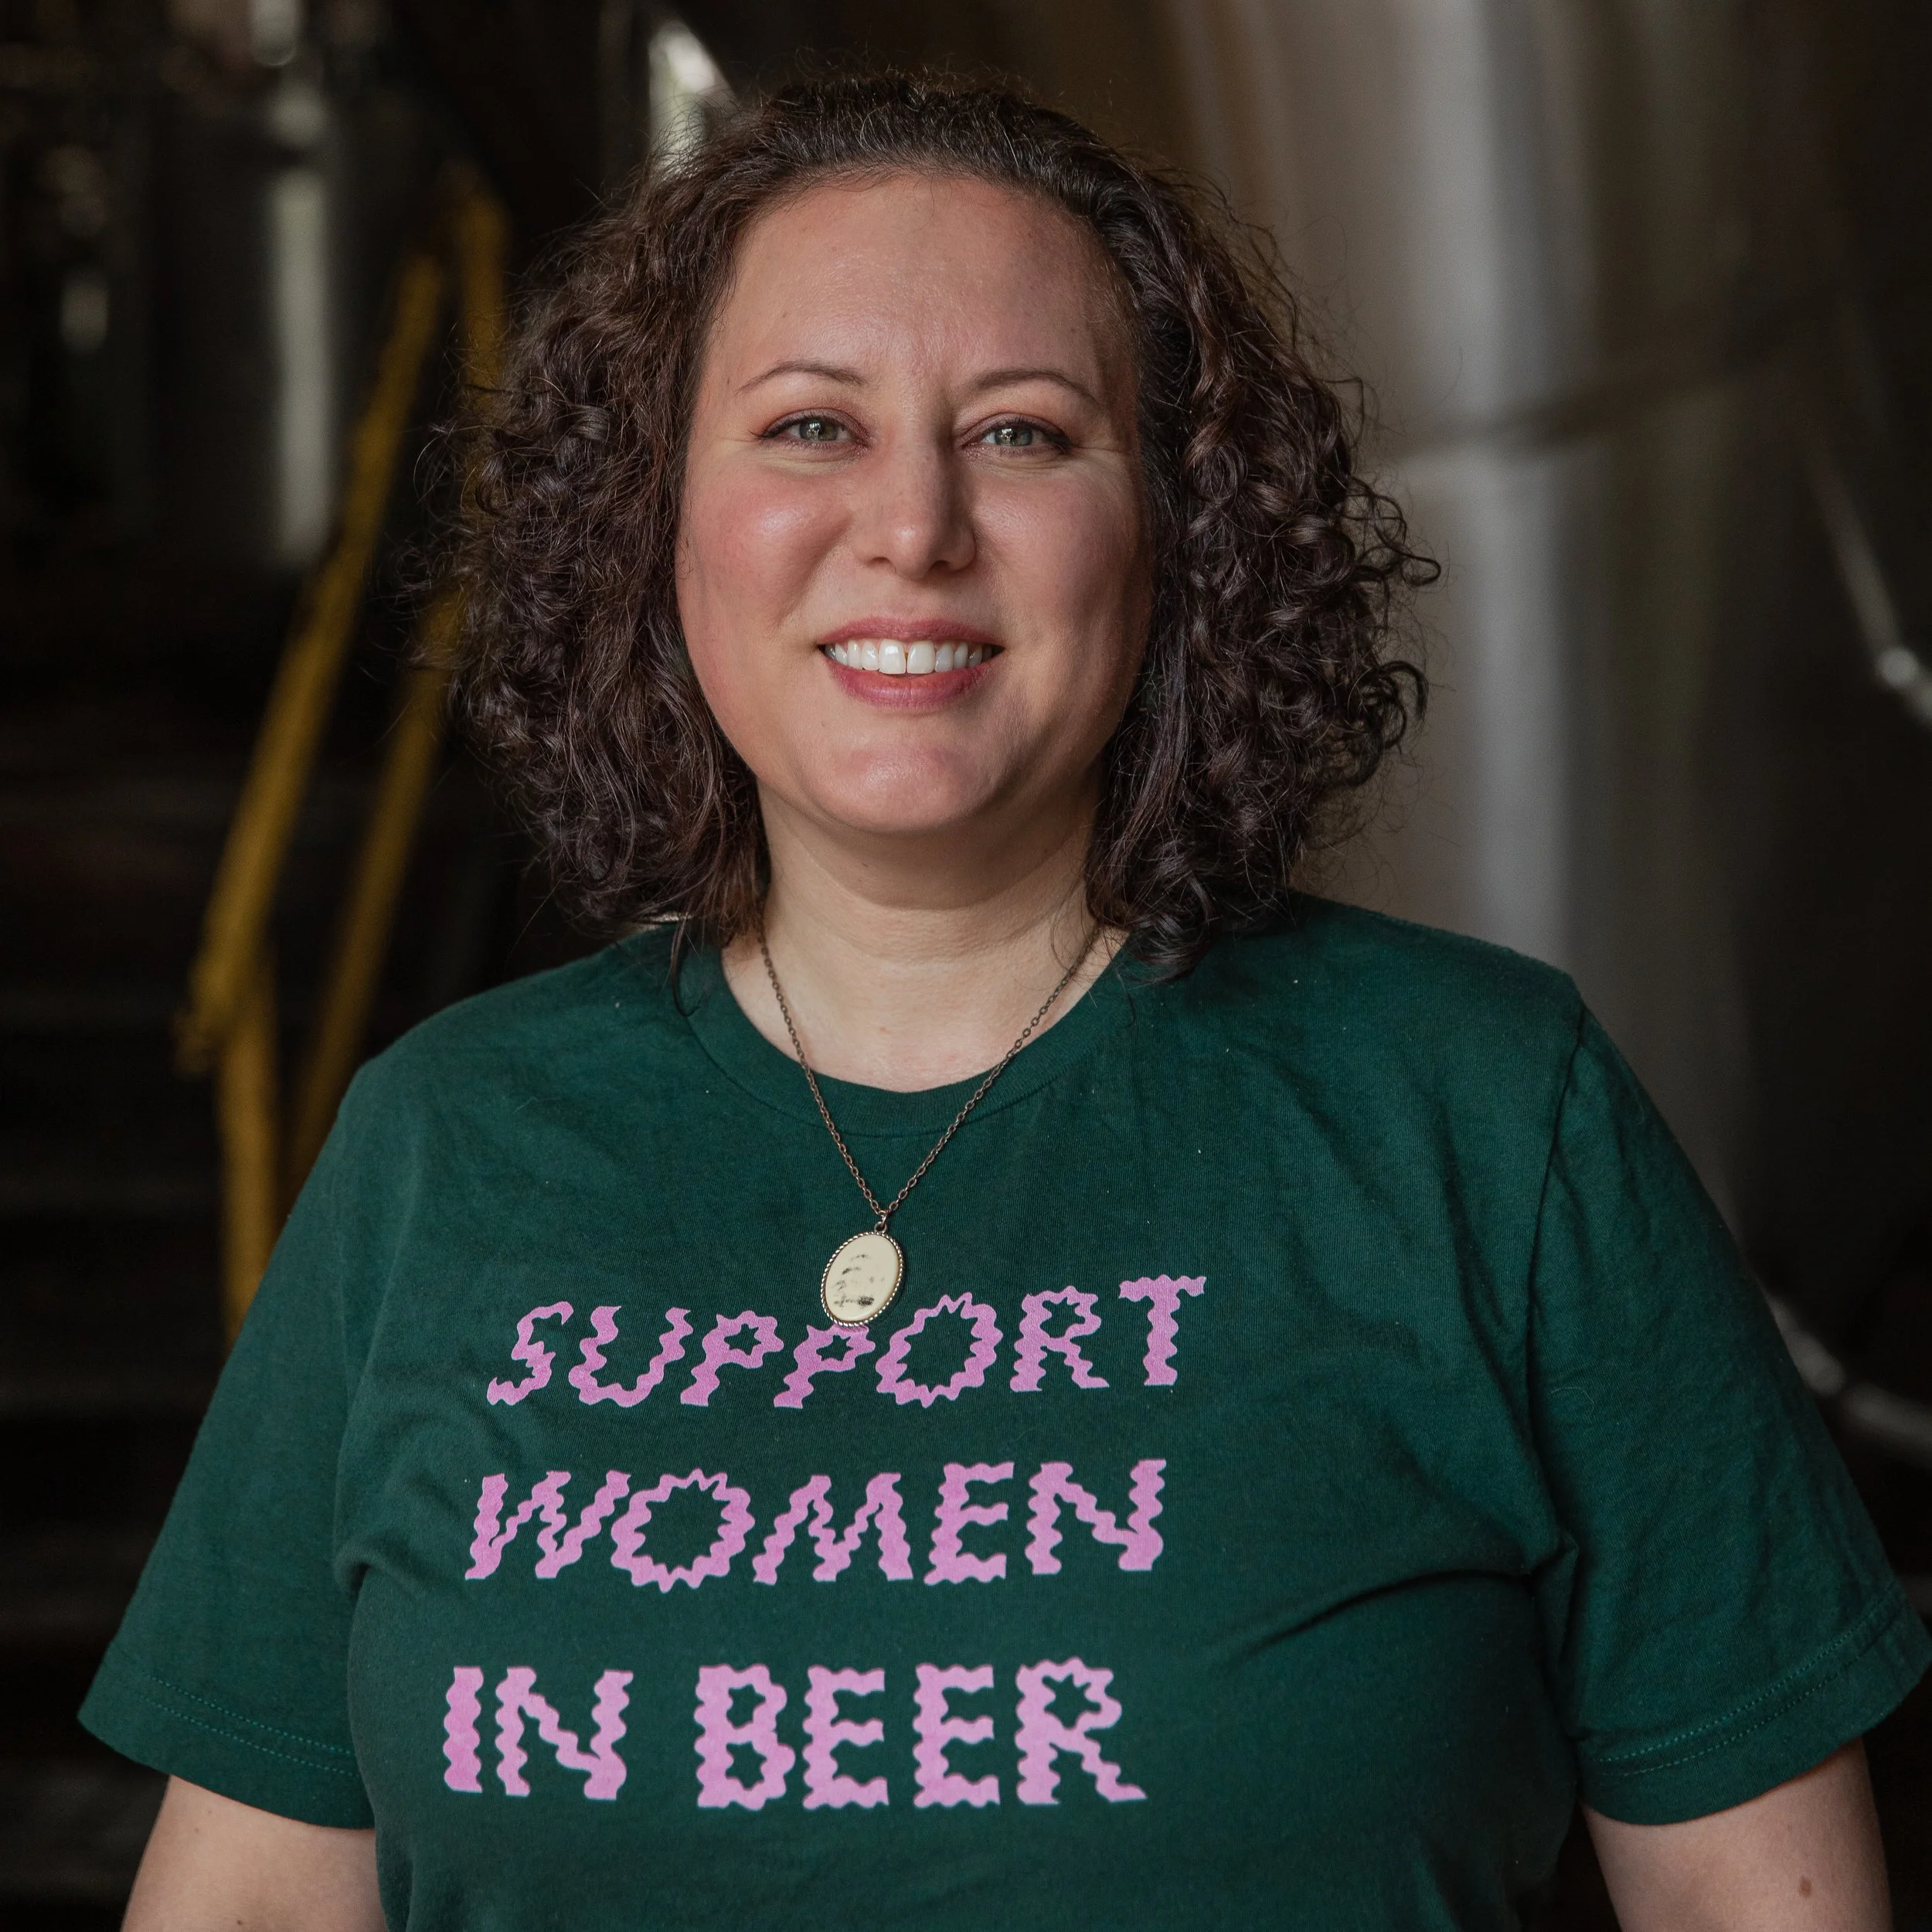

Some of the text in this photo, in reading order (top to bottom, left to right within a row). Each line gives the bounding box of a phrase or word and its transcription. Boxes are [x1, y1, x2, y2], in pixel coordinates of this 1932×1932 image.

[488, 1275, 1205, 1406] SUPPORT
[465, 1459, 1165, 1591] WOMEN
[443, 1657, 1147, 1809] IN BEER
